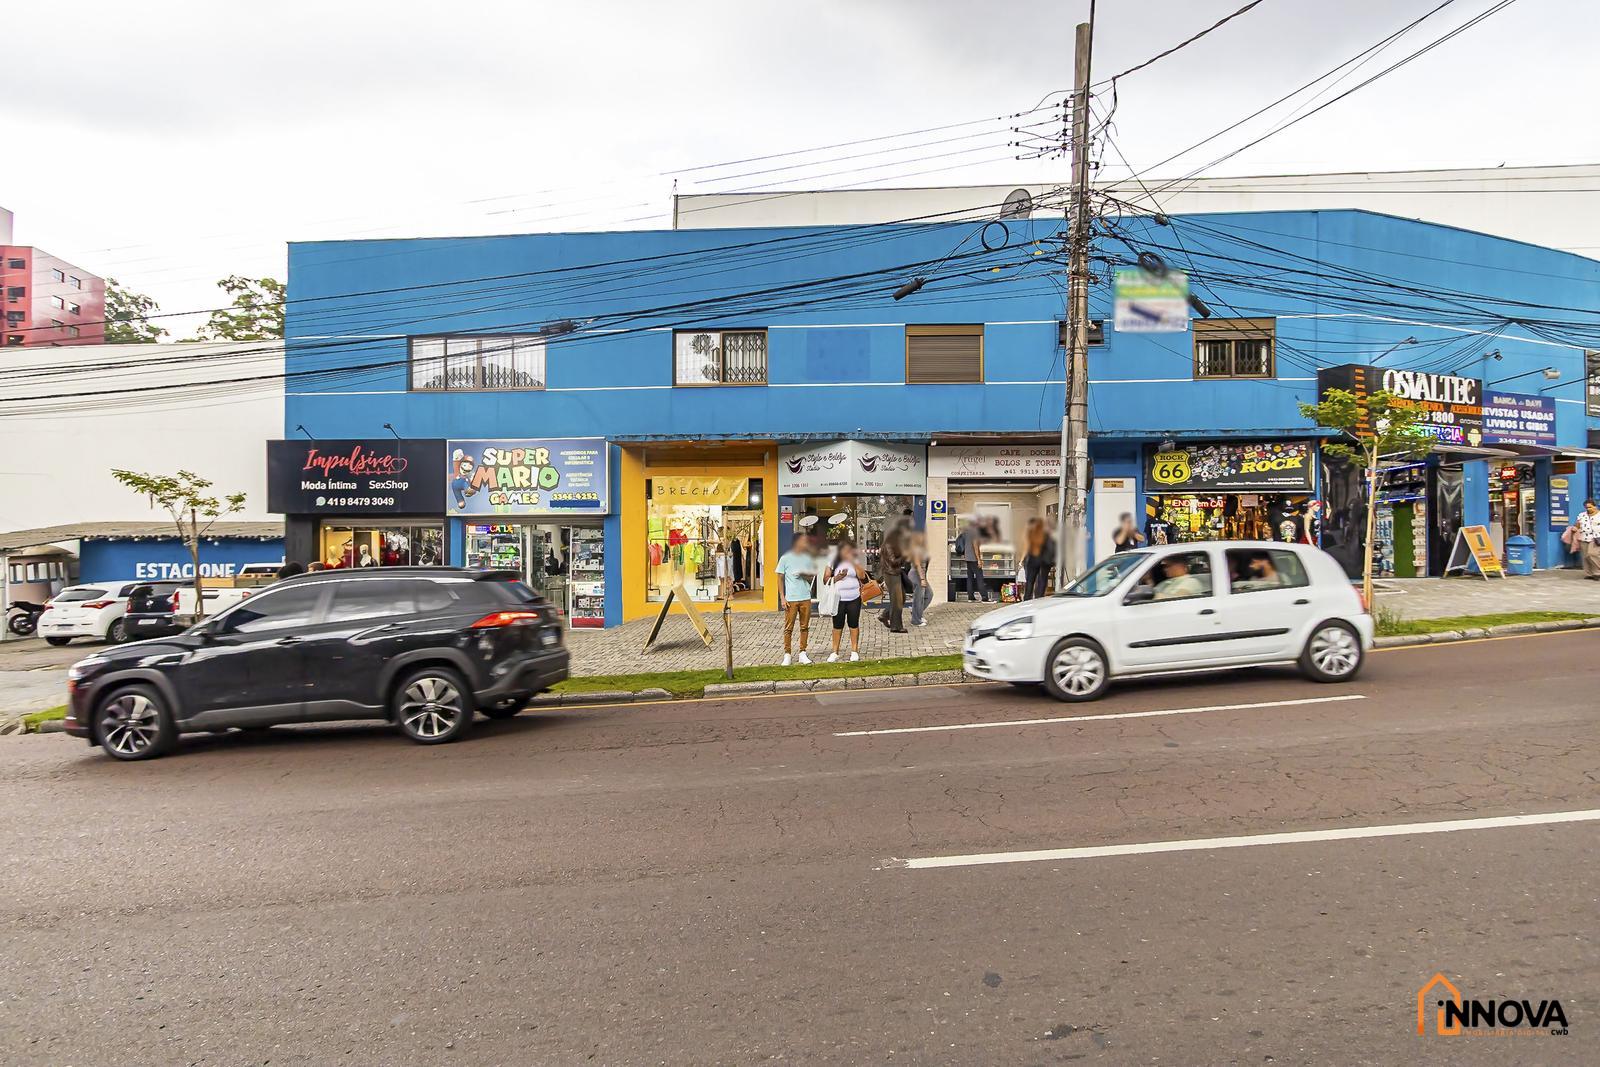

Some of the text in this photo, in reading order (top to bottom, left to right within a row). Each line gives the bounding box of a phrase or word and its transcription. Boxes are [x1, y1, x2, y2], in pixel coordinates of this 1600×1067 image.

[1383, 369, 1475, 404] OSVALTEC
[1432, 412, 1454, 424] 1800
[1521, 410, 1555, 421] USADAS
[1486, 418, 1518, 430] LIVROS
[1519, 422, 1525, 430] E
[303, 445, 393, 477] Impulsive
[483, 447, 550, 466] SUPER
[995, 459, 1020, 467] BOLOS
[1159, 463, 1184, 479] 66
[1240, 457, 1302, 473] ROCK
[301, 478, 357, 490] Moda Íntima
[471, 465, 560, 491] MARIO
[368, 480, 409, 490] SexShop
[347, 497, 370, 506] 8479
[371, 497, 394, 506] 3049
[489, 492, 541, 505] GAMES
[135, 562, 235, 578] ESTACIONE
